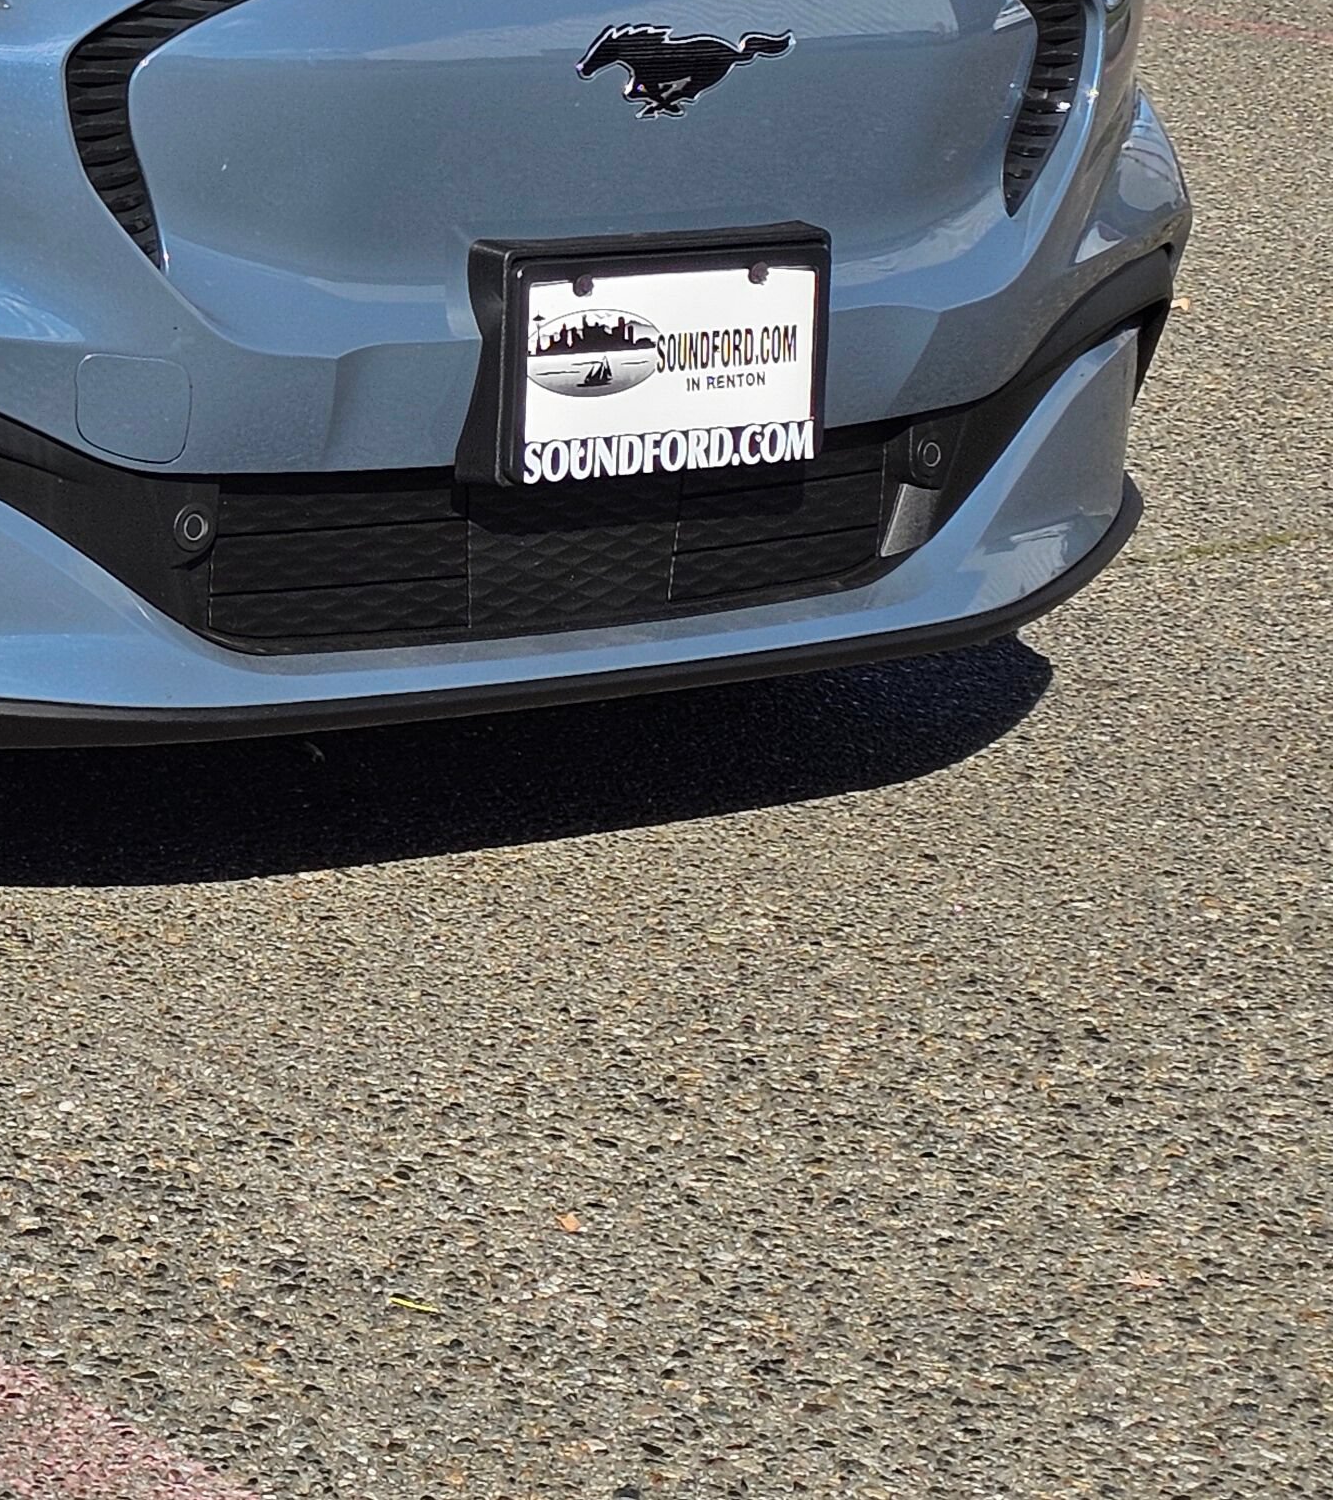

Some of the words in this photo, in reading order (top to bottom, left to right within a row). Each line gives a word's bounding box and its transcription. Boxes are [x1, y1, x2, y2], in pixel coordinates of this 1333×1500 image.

[656, 324, 797, 374] SOUNDFORD.COM
[686, 377, 701, 392] IN
[706, 371, 767, 391] RENTON
[522, 420, 815, 485] SOUNDFORD.COM
